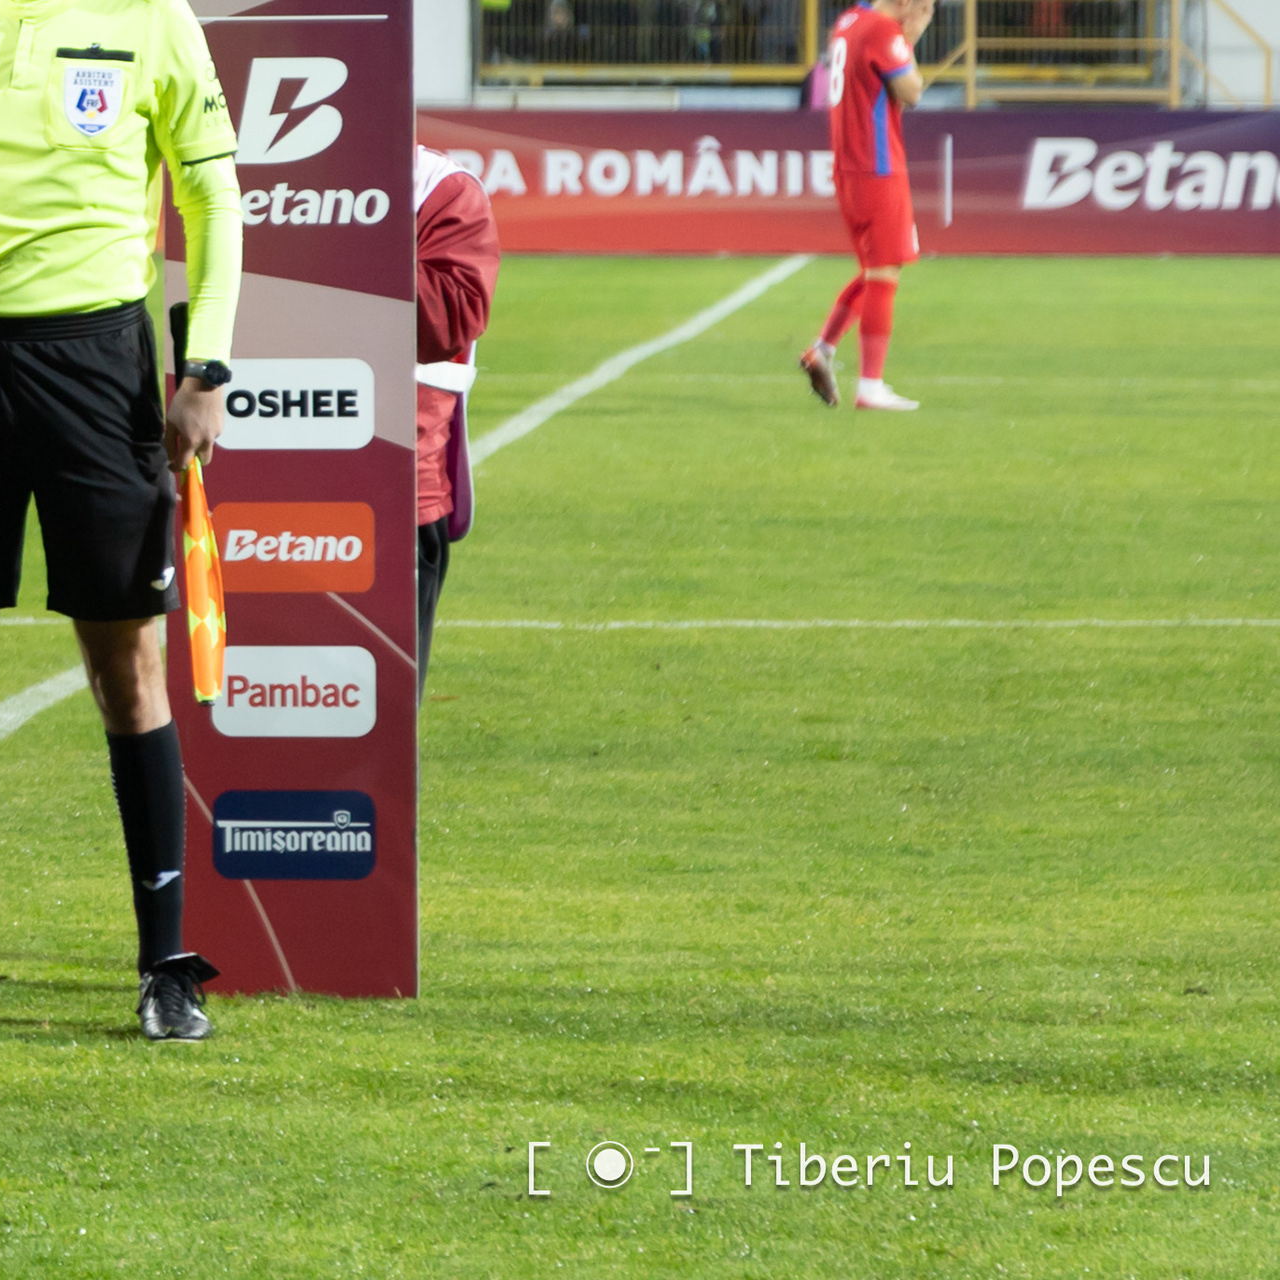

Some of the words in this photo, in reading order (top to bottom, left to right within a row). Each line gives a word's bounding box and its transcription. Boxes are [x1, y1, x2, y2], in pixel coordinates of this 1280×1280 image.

[234, 56, 349, 165] B
[544, 134, 836, 198] ROMÂNIE
[1022, 136, 1280, 212] Betan
[242, 182, 390, 226] etano
[225, 388, 360, 419] OSHEE
[224, 529, 363, 563] Betano
[227, 674, 360, 708] Pambac
[216, 819, 372, 854] Timișoreana
